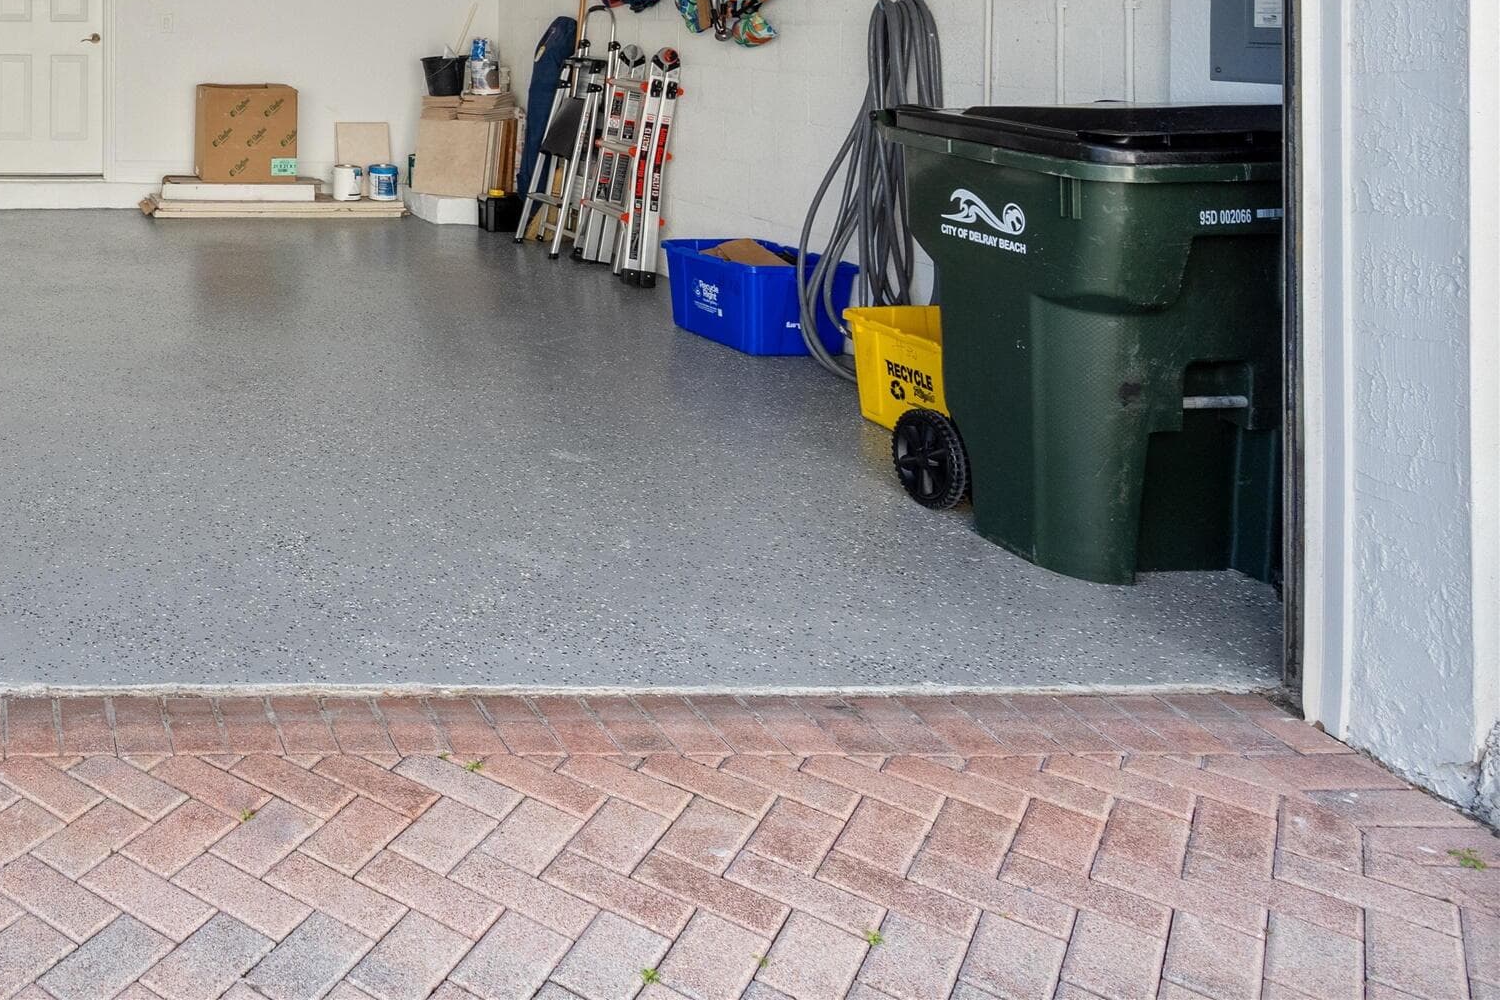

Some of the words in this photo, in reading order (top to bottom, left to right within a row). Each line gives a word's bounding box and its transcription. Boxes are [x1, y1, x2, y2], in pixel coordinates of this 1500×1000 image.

[1199, 209, 1218, 226] 95D
[1219, 208, 1252, 225] 002066
[940, 223, 957, 237] CITY
[957, 227, 969, 240] OF
[968, 230, 998, 248] DELRAY
[998, 238, 1027, 255] BEACH
[884, 359, 934, 392] RECYCLE
